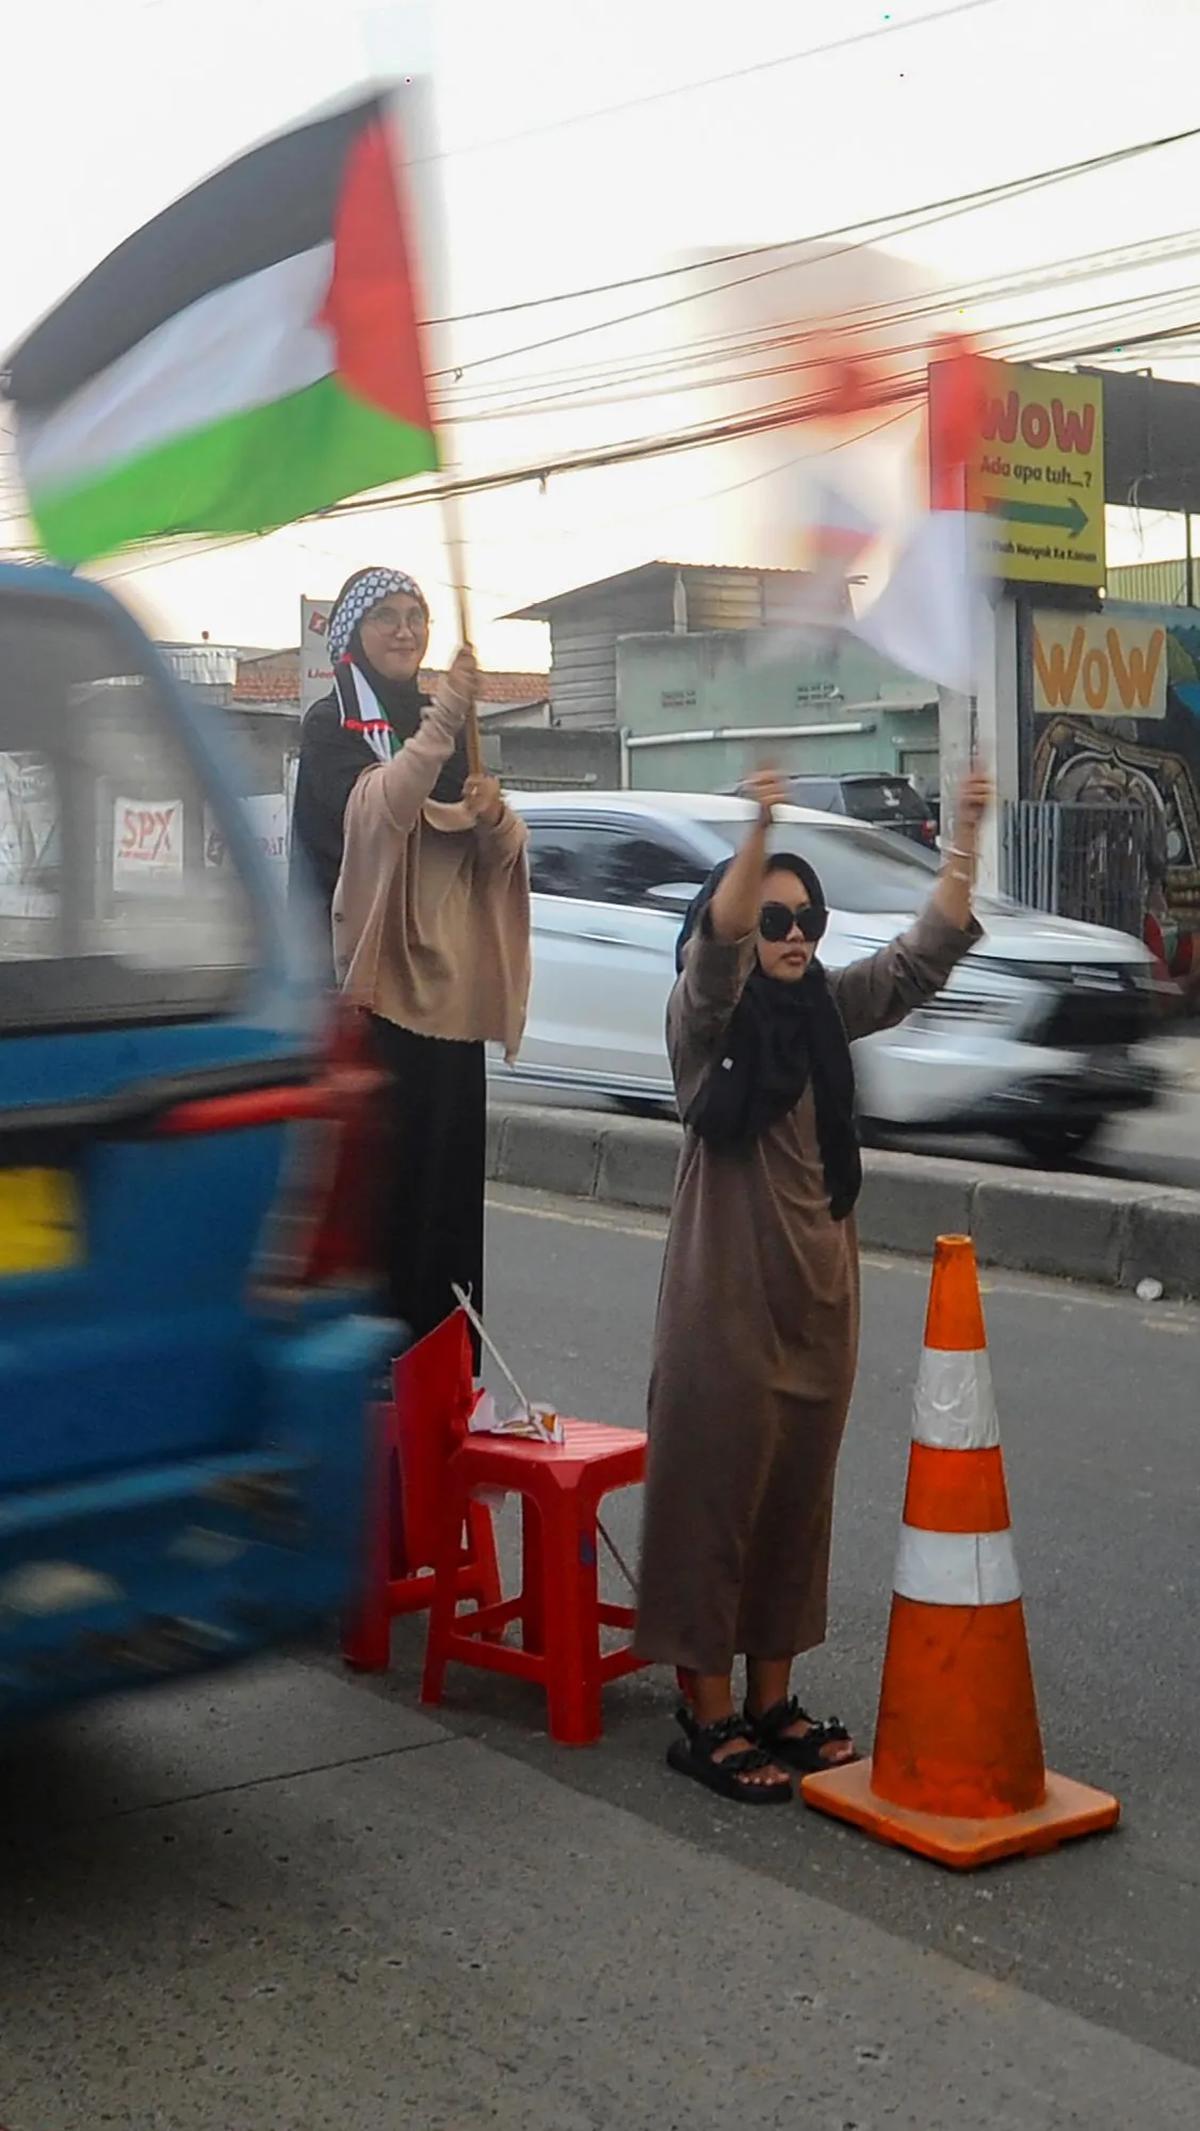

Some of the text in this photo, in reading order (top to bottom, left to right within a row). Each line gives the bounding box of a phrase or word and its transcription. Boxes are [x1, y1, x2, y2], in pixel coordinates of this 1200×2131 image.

[981, 456, 1010, 476] Ada
[1013, 464, 1042, 485] apa
[1032, 625, 1166, 710] WOW
[120, 807, 175, 859] SPX
